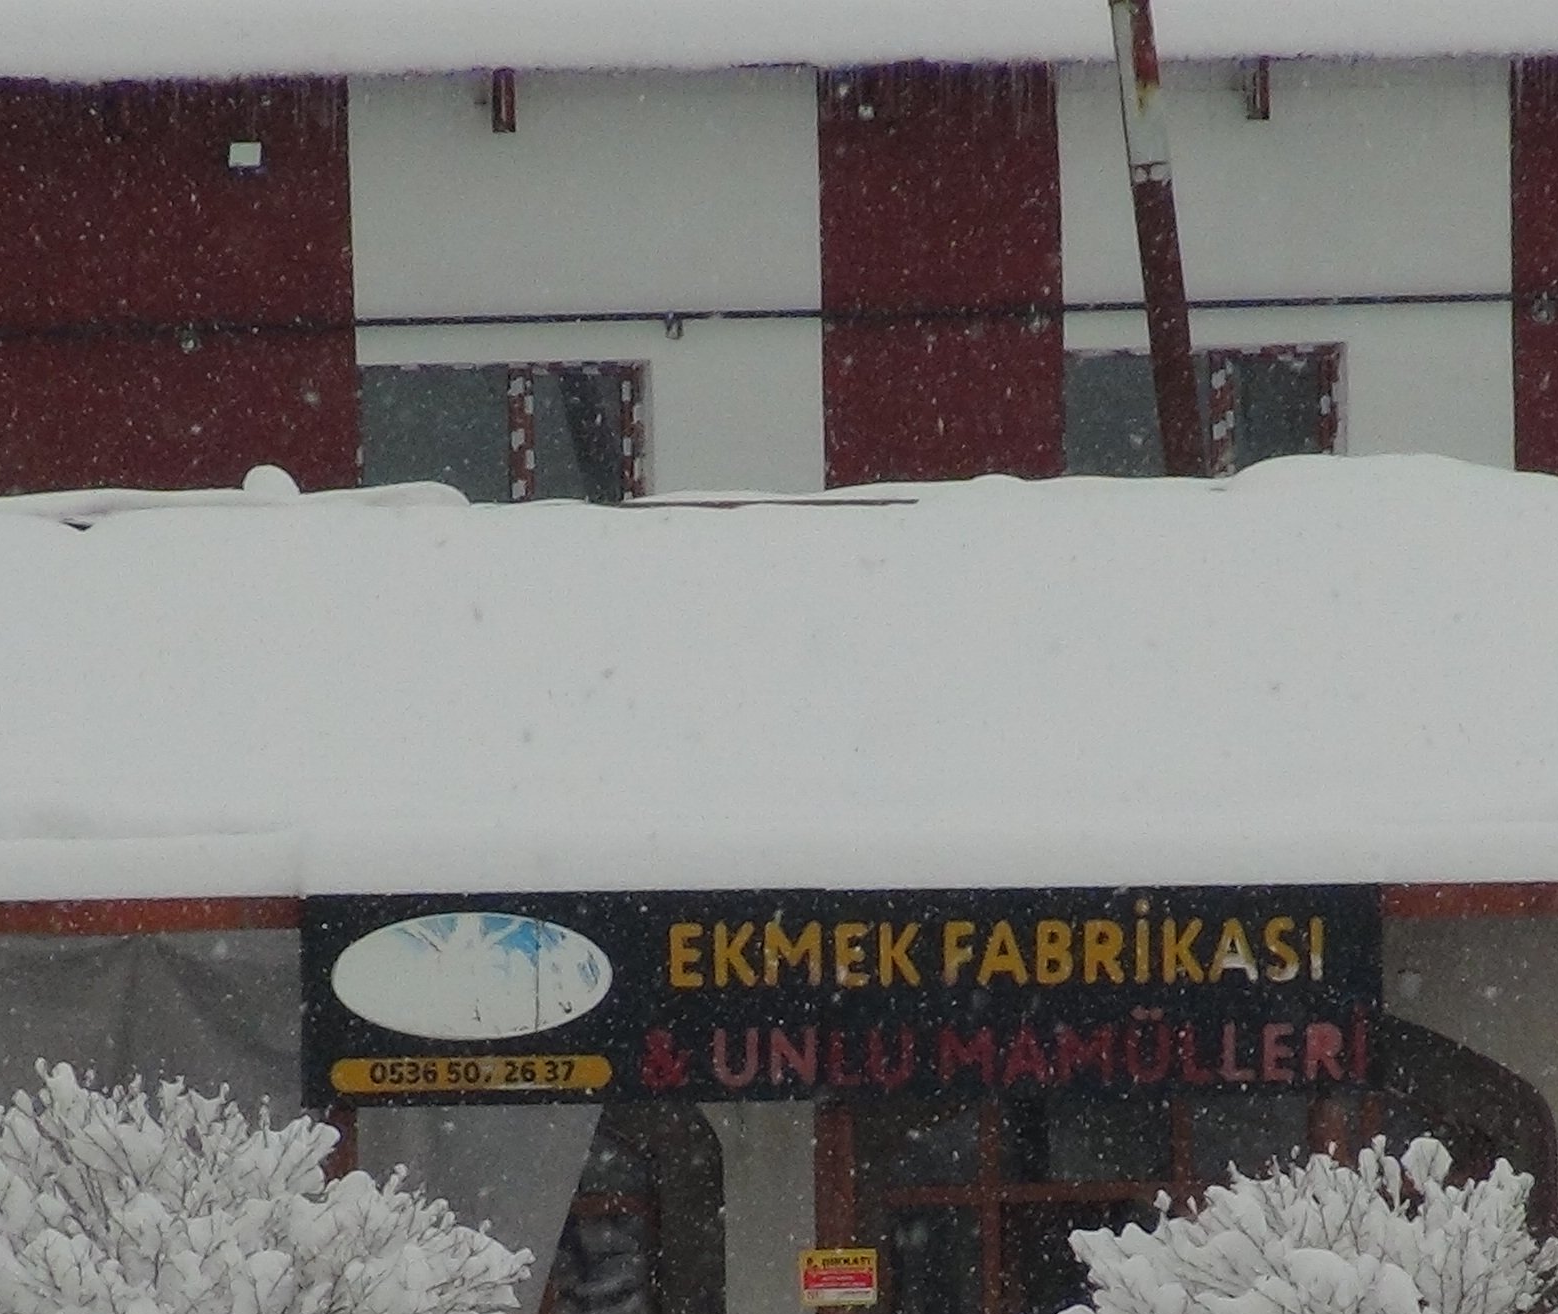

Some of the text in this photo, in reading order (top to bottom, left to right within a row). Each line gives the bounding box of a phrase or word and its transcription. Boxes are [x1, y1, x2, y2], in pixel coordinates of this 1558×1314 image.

[667, 899, 1326, 989] EKMEK FABRİKASI
[369, 1061, 438, 1085] 0536
[504, 1059, 537, 1083] 26
[544, 1059, 576, 1083] 37
[640, 1003, 1370, 1089] & UNLU MAMÜLLERİ
